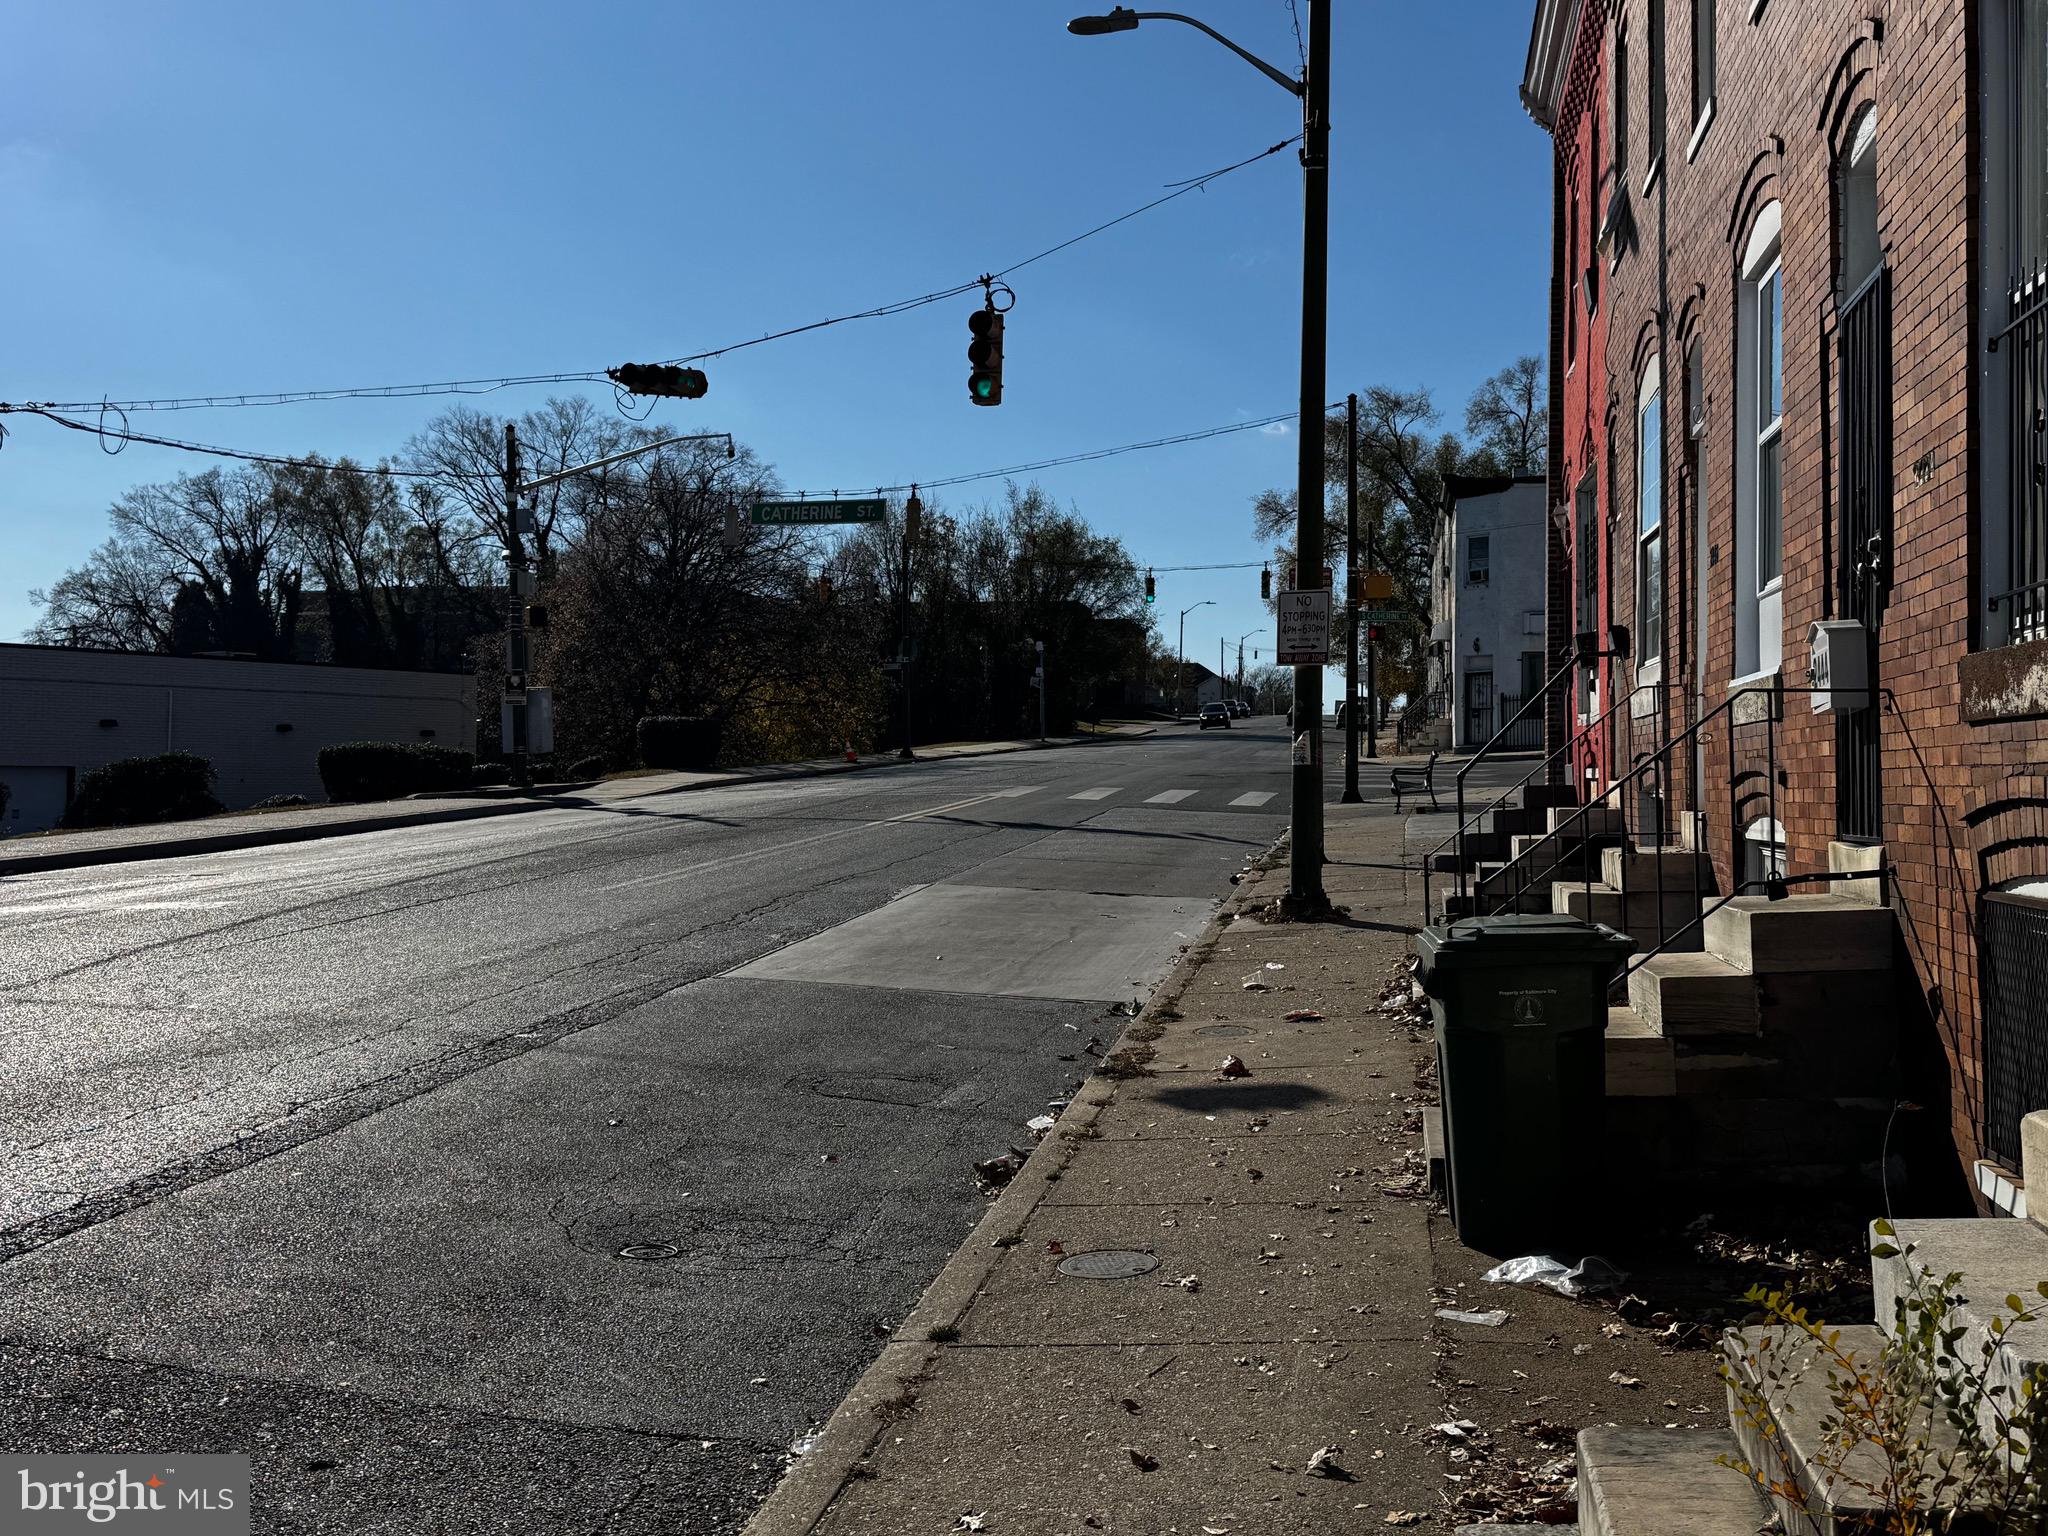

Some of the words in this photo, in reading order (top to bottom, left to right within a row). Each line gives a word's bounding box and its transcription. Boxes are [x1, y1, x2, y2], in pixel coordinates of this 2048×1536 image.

[761, 505, 842, 521] CATHERINE
[857, 505, 876, 517] ST.
[1296, 595, 1312, 606] NO
[1282, 610, 1325, 622] STOPPING
[1366, 612, 1400, 620] CATHERINE
[1280, 654, 1293, 663] TOW
[1294, 654, 1310, 662] AWAY
[1311, 654, 1326, 662] ZONE
